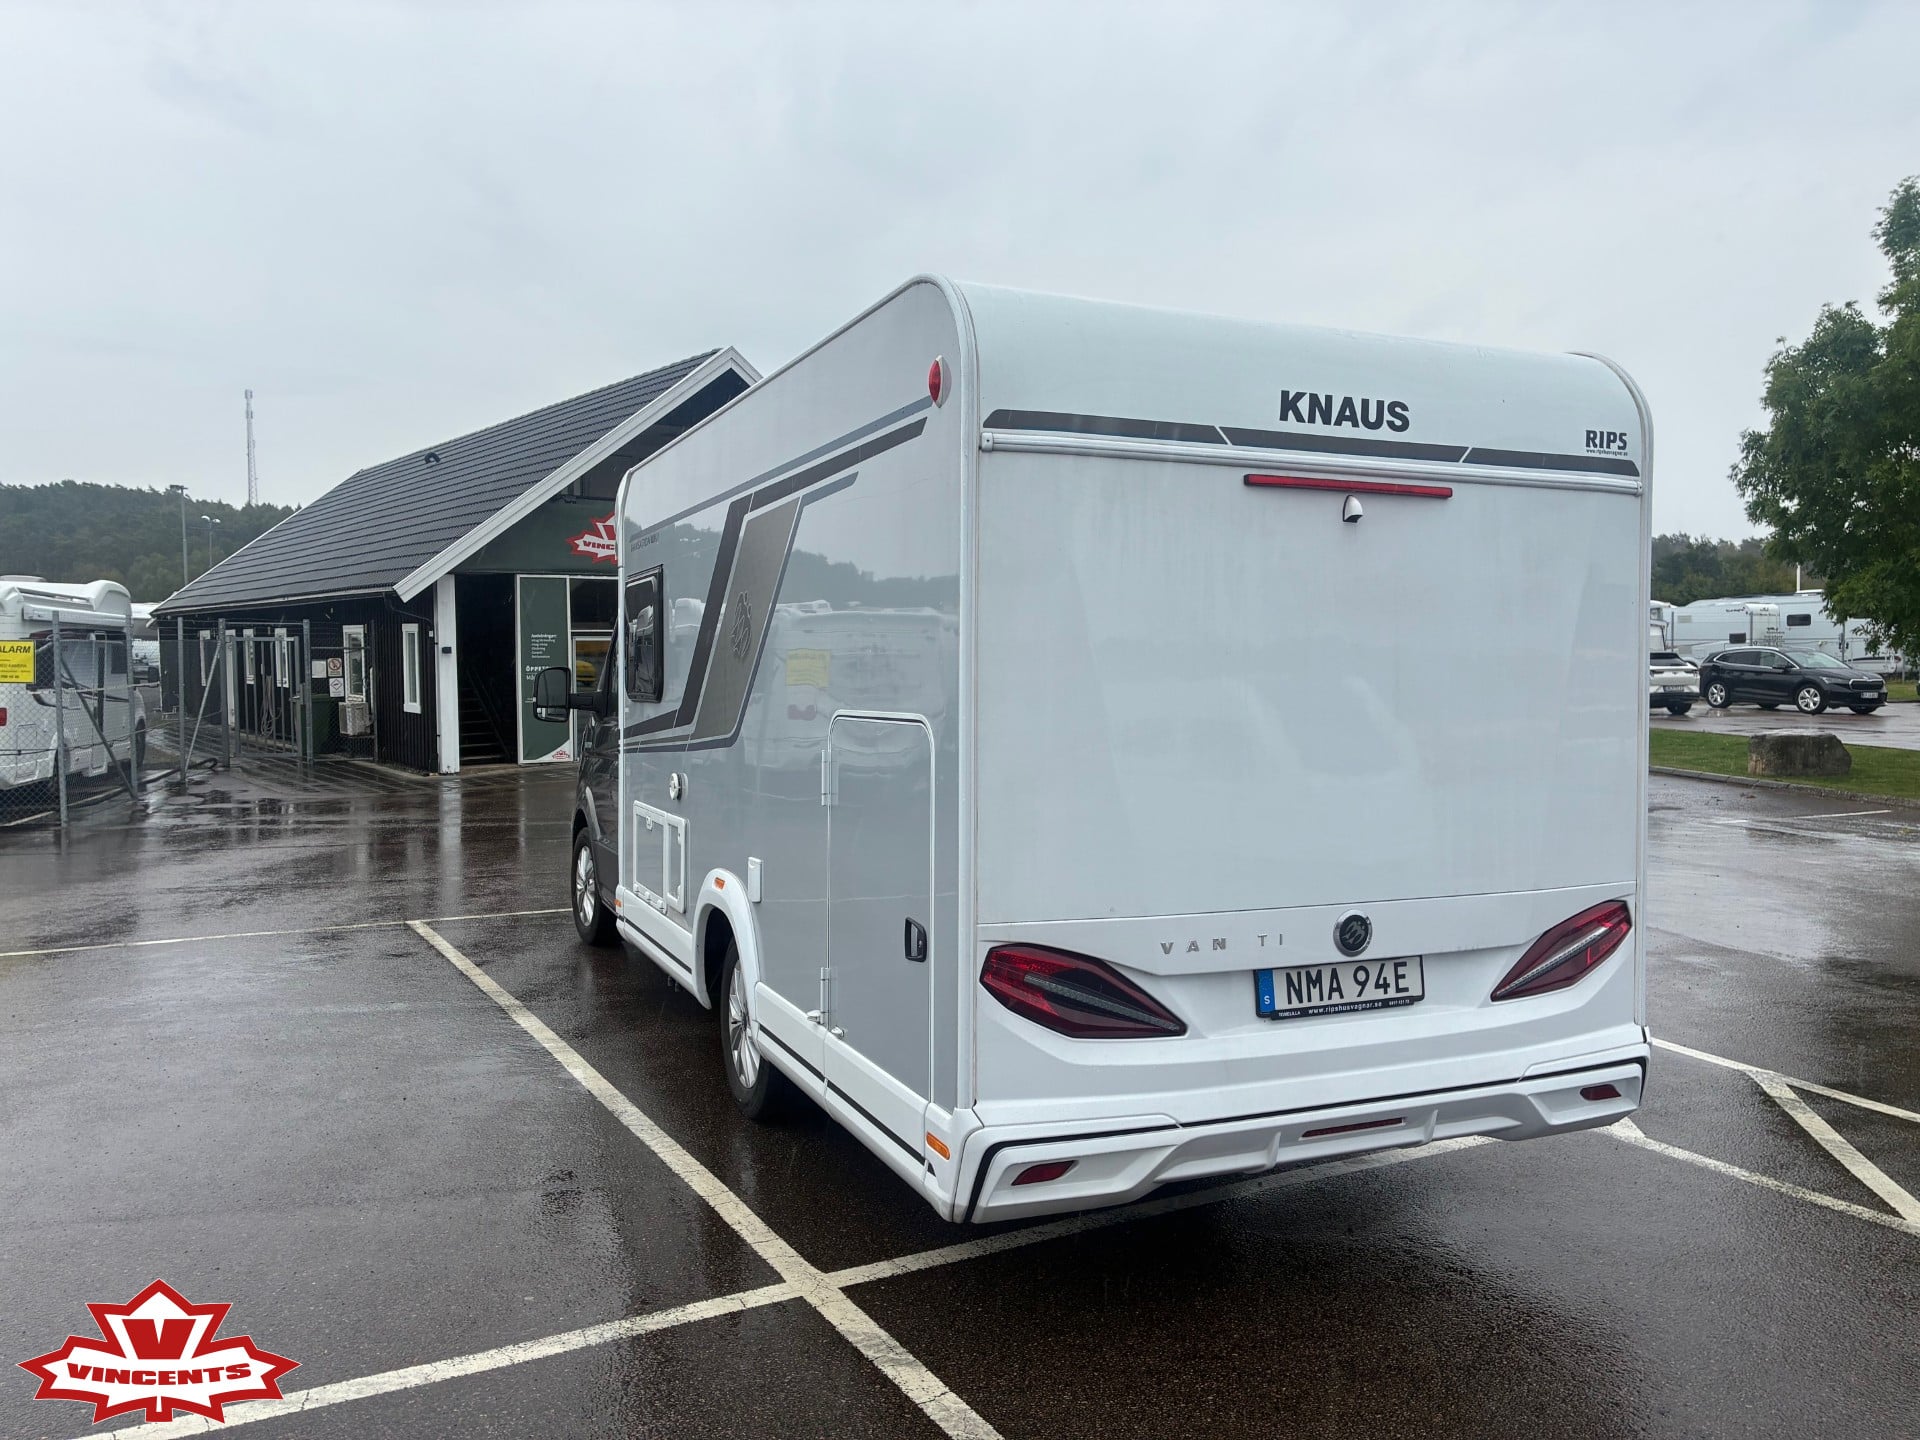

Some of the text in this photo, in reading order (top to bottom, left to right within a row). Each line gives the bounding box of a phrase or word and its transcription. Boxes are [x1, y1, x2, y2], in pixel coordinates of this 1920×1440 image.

[1279, 389, 1410, 433] KNAUS
[1585, 429, 1628, 451] RIPS
[582, 540, 615, 550] VINC
[1160, 937, 1227, 955] VAN
[1263, 961, 1410, 1005] S NMA 94E
